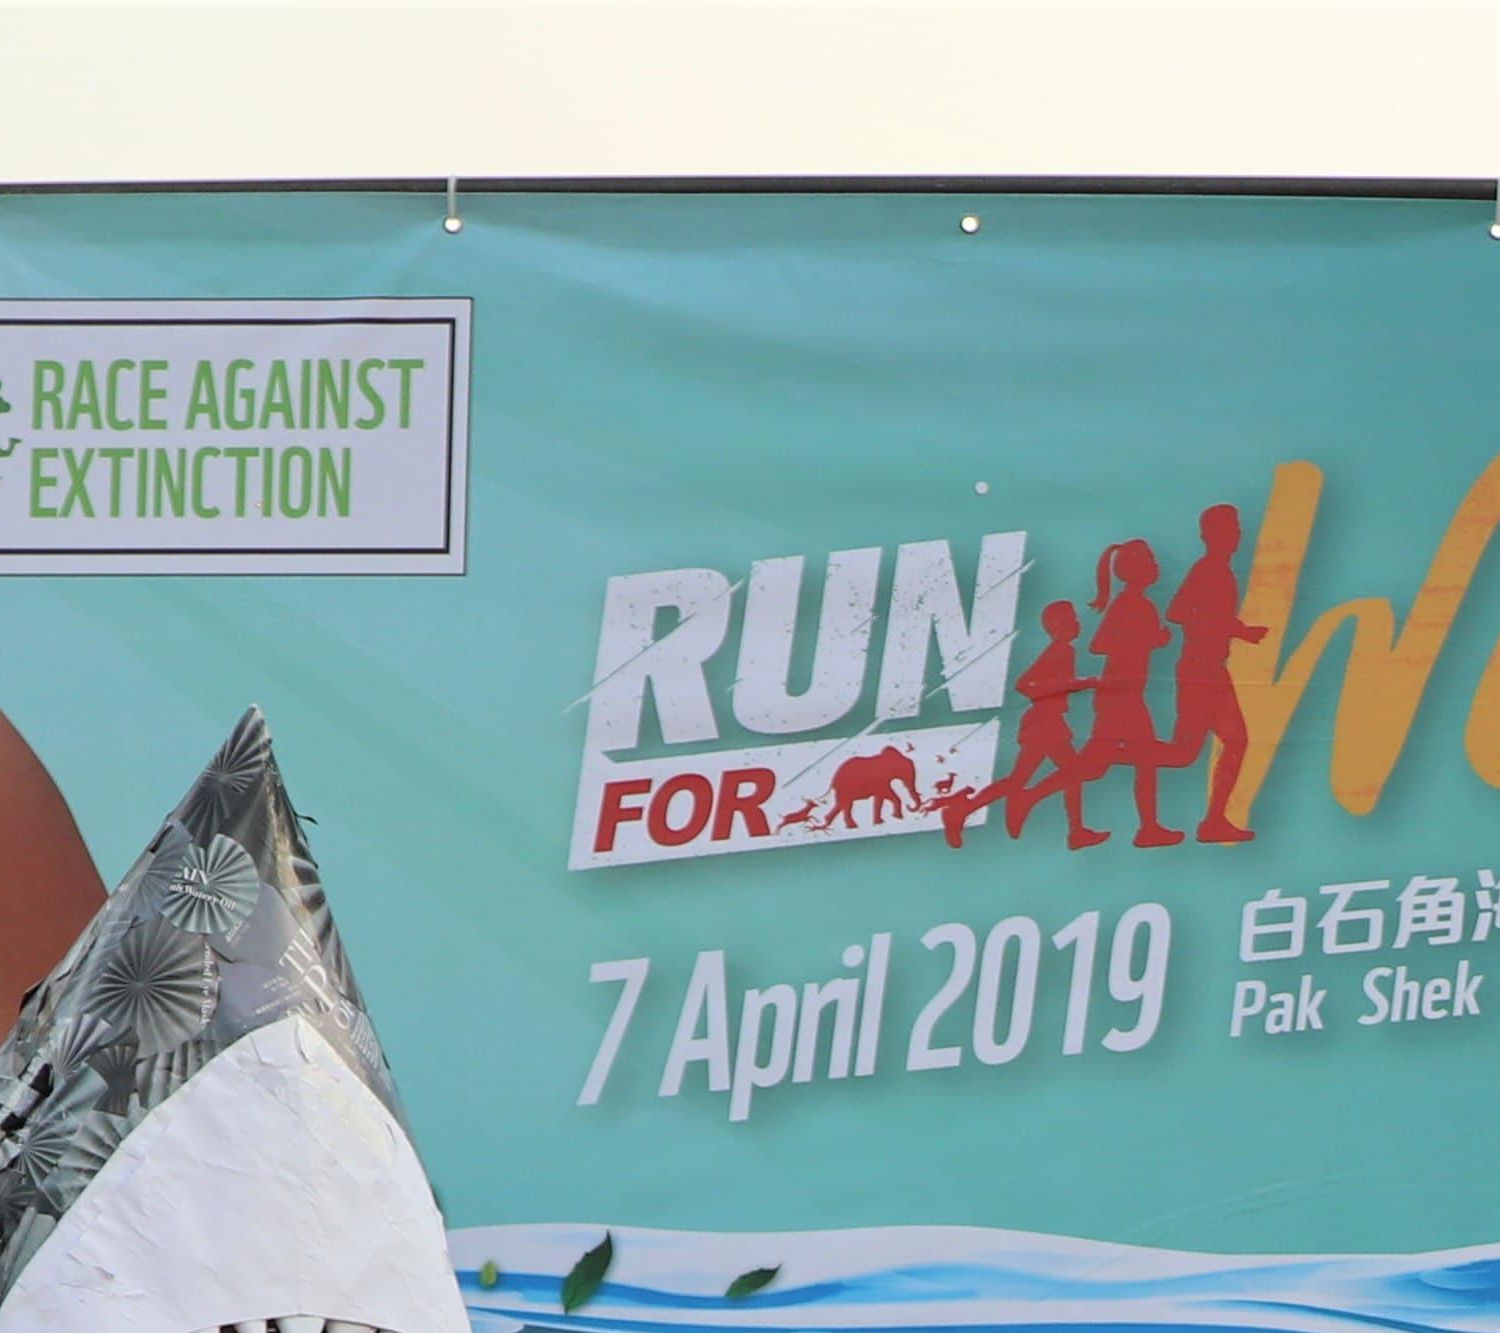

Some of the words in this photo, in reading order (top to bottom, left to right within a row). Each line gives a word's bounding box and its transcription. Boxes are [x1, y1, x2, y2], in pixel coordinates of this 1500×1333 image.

[30, 359, 169, 431] RACE
[184, 356, 425, 431] AGAINST
[28, 445, 353, 521] EXTINCTION
[600, 531, 1027, 752] RUN
[591, 764, 779, 854] FOR
[577, 958, 650, 1107] 7
[657, 928, 895, 1122] April
[906, 902, 1173, 1073] 2019
[1229, 975, 1325, 1039] Pak
[1359, 964, 1483, 1028] Shek
